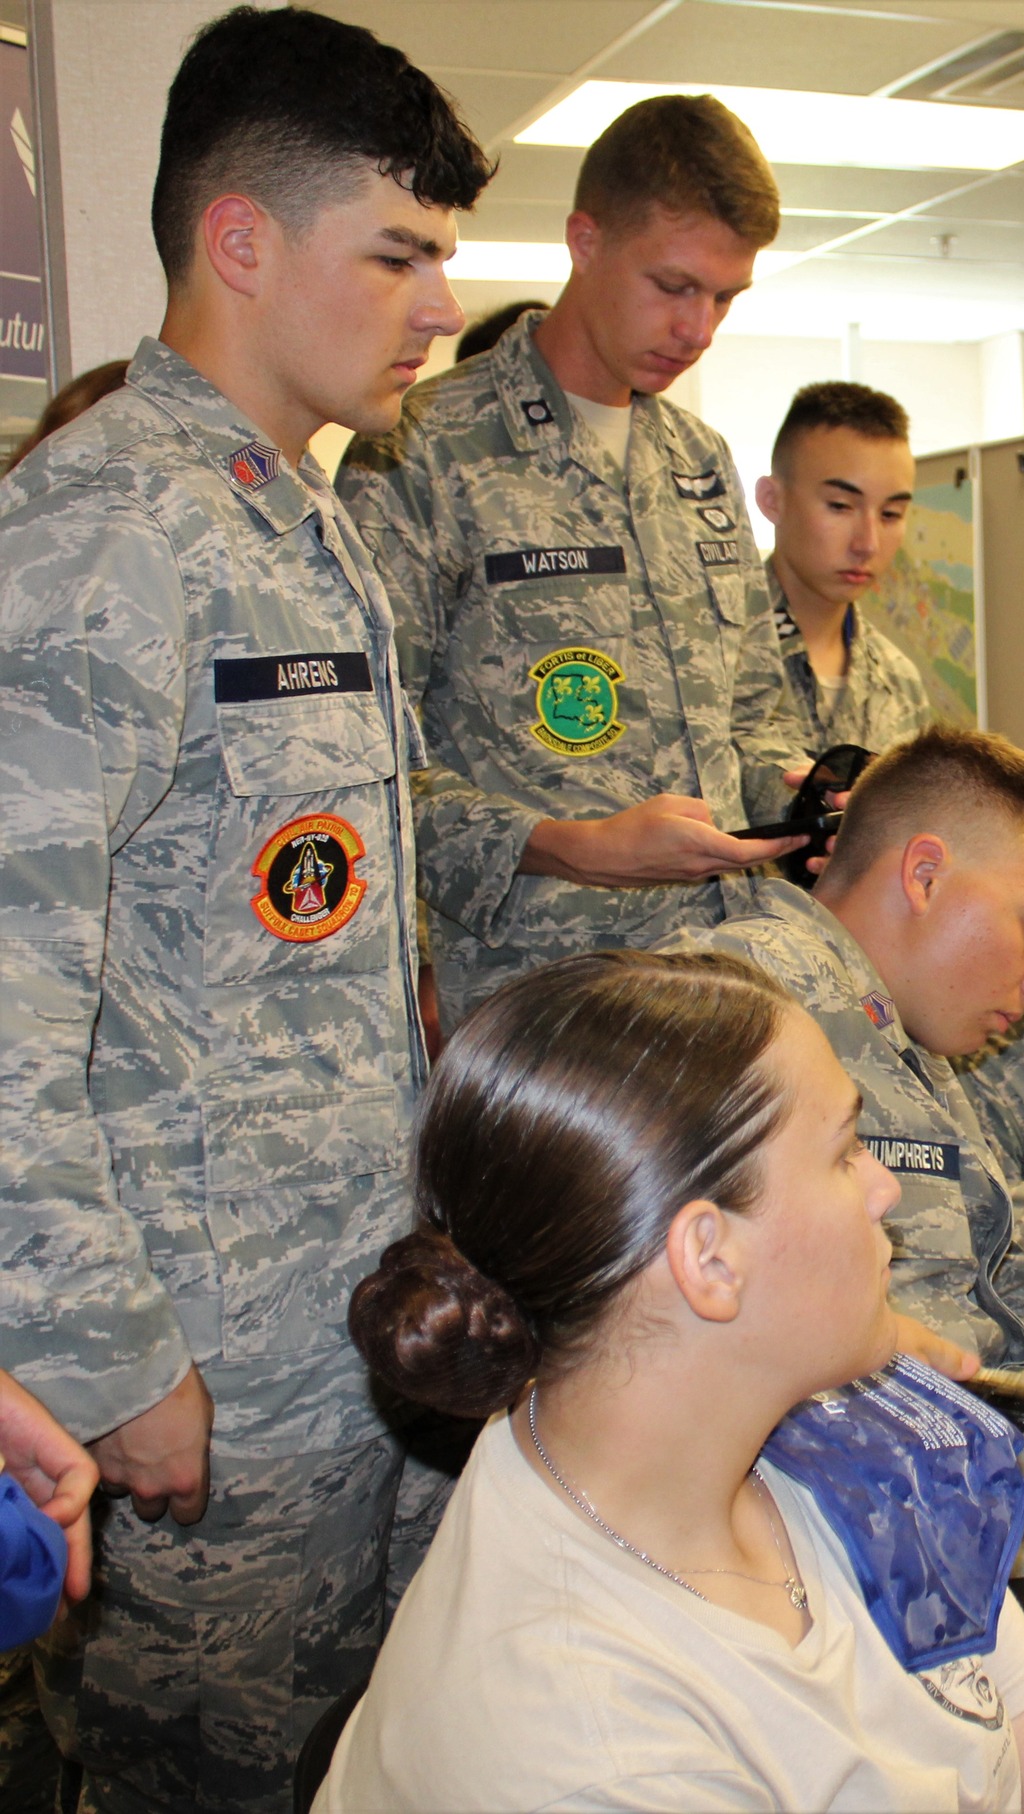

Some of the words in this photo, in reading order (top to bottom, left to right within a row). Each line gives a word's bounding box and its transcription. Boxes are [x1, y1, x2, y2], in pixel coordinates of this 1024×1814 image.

[522, 550, 589, 573] WATSON
[278, 660, 339, 691] AHRENS
[539, 652, 574, 674] FORTIS
[588, 654, 615, 676] LIBER
